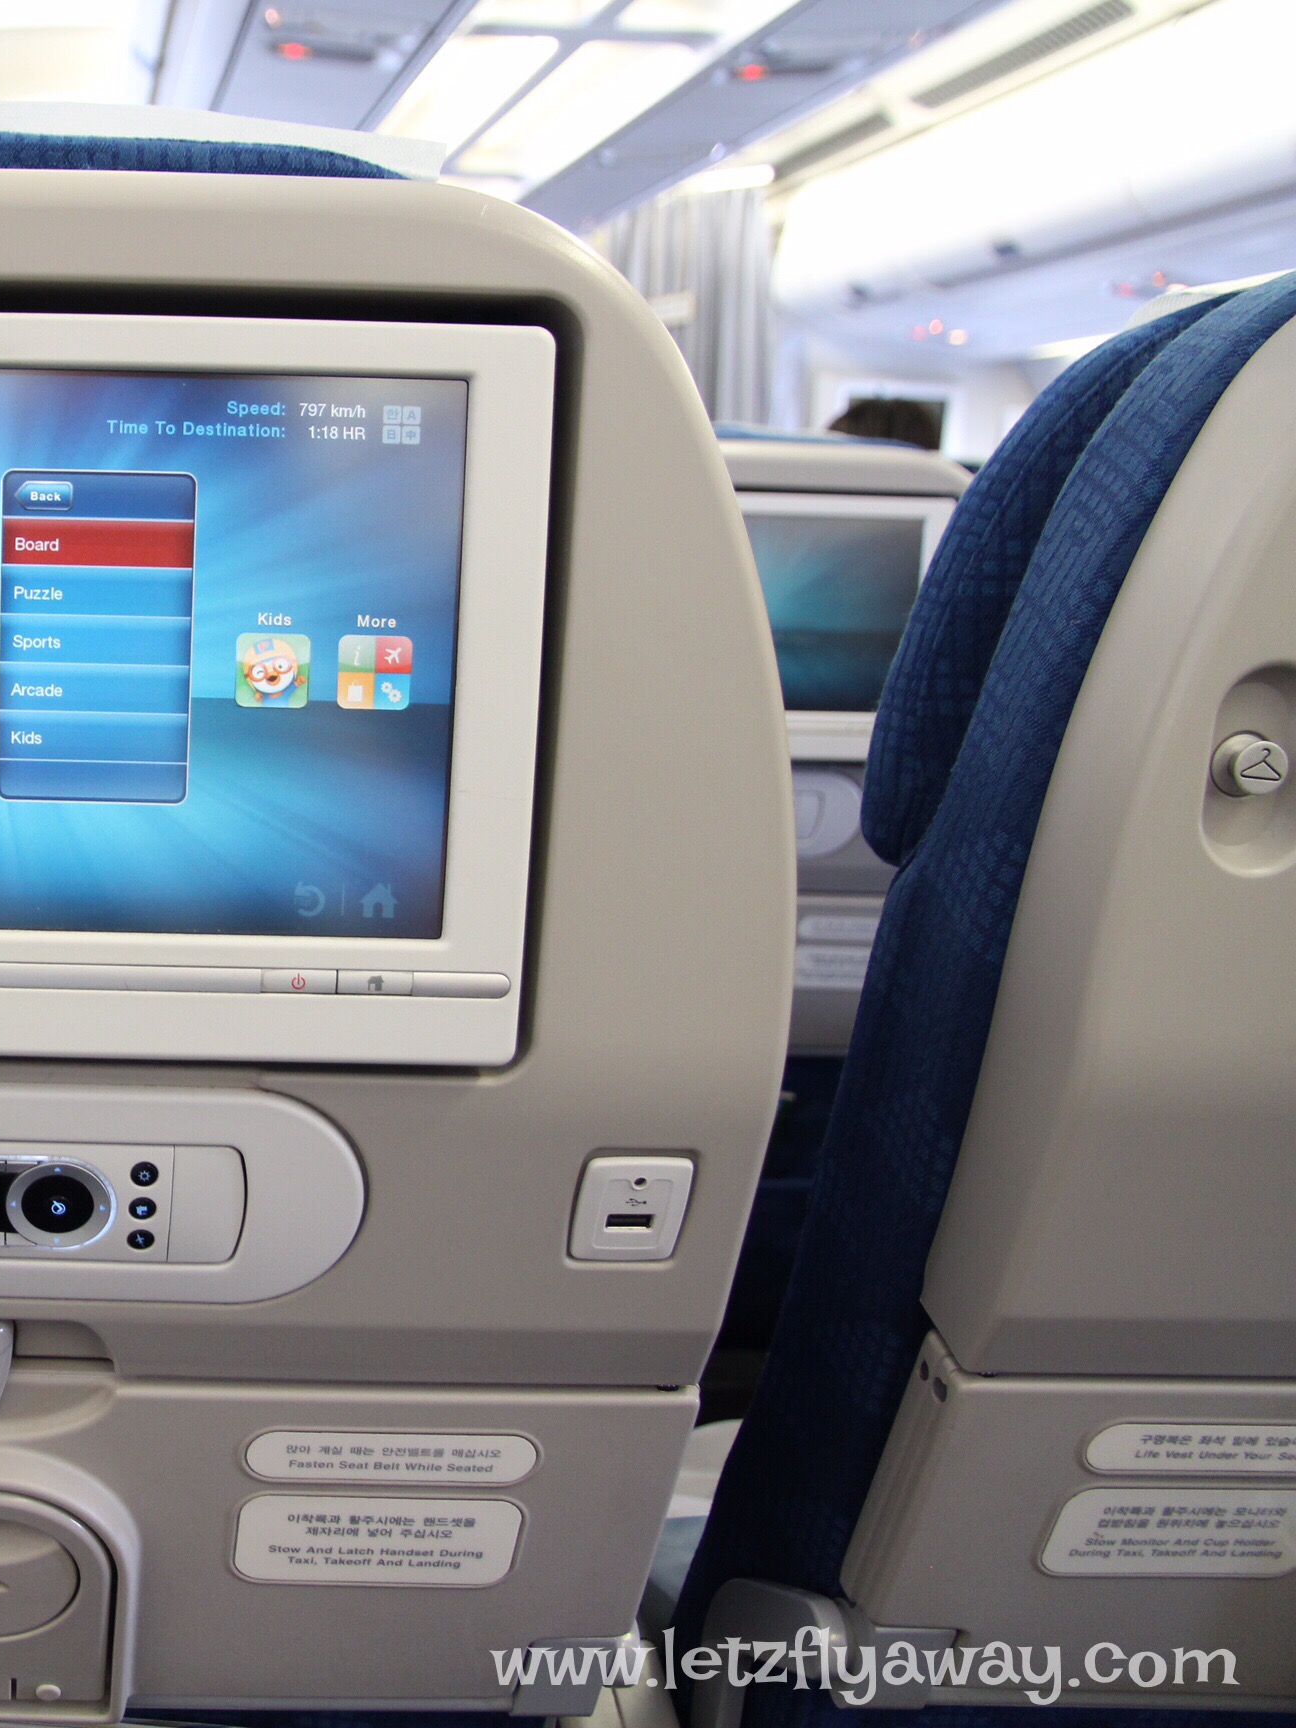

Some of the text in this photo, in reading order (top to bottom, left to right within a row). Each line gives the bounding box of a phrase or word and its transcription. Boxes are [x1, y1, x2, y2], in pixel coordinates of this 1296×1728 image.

[227, 401, 366, 419] Speed: 797 km/h
[107, 420, 366, 441] Time To Destination: 1:18 HR
[30, 490, 62, 503] Back
[14, 537, 59, 553] Board
[13, 586, 63, 602] Puzzle
[257, 612, 292, 627] Kids
[357, 615, 397, 629] More
[12, 635, 61, 652] Sports
[10, 683, 63, 698] Arcade
[10, 731, 42, 746] Kids
[1134, 1450, 1160, 1459] Life
[1165, 1450, 1194, 1459] Vest
[1199, 1451, 1239, 1460] Under
[1244, 1451, 1272, 1460] Your
[289, 1459, 493, 1473] Fasten Seat Belt While Seated
[1085, 1537, 1276, 1548] Stow Monitor And Cup Holder
[268, 1544, 484, 1560] Stow And Latch Handset During
[1069, 1549, 1112, 1559] During
[1151, 1549, 1196, 1558] Takeoff
[1200, 1550, 1226, 1558] And
[1230, 1550, 1283, 1560] Landing
[288, 1556, 461, 1569] Taxi, Takeoff And Landing
